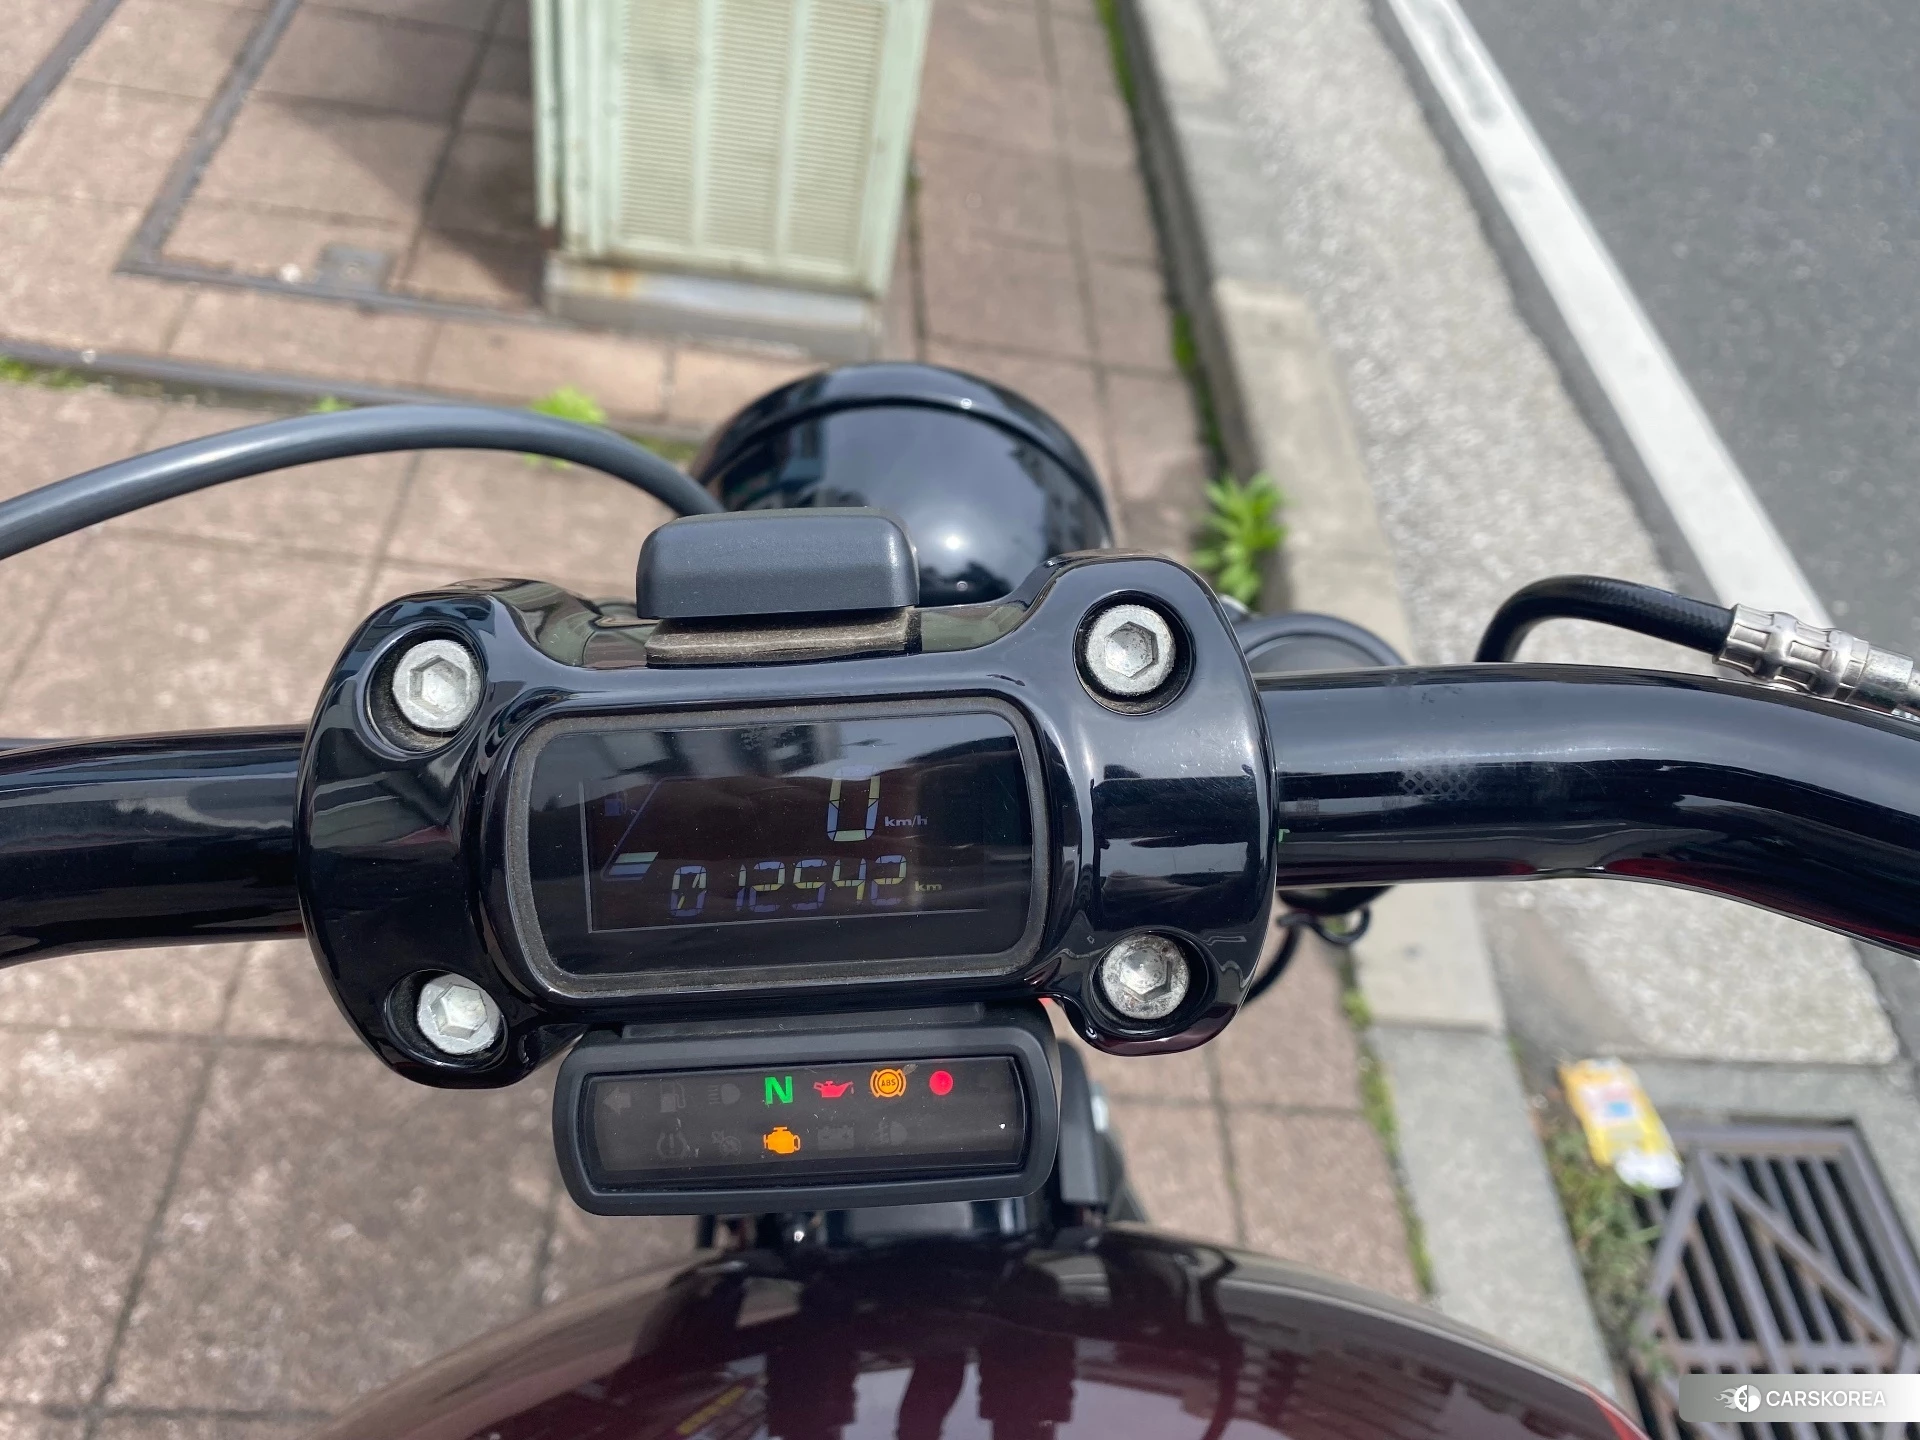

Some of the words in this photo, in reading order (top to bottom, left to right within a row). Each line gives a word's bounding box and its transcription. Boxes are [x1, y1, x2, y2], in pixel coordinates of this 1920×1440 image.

[884, 815, 928, 828] km/h
[669, 854, 907, 917] 012542
[914, 881, 943, 893] km
[764, 1075, 794, 1105] N
[880, 1078, 897, 1088] ABS
